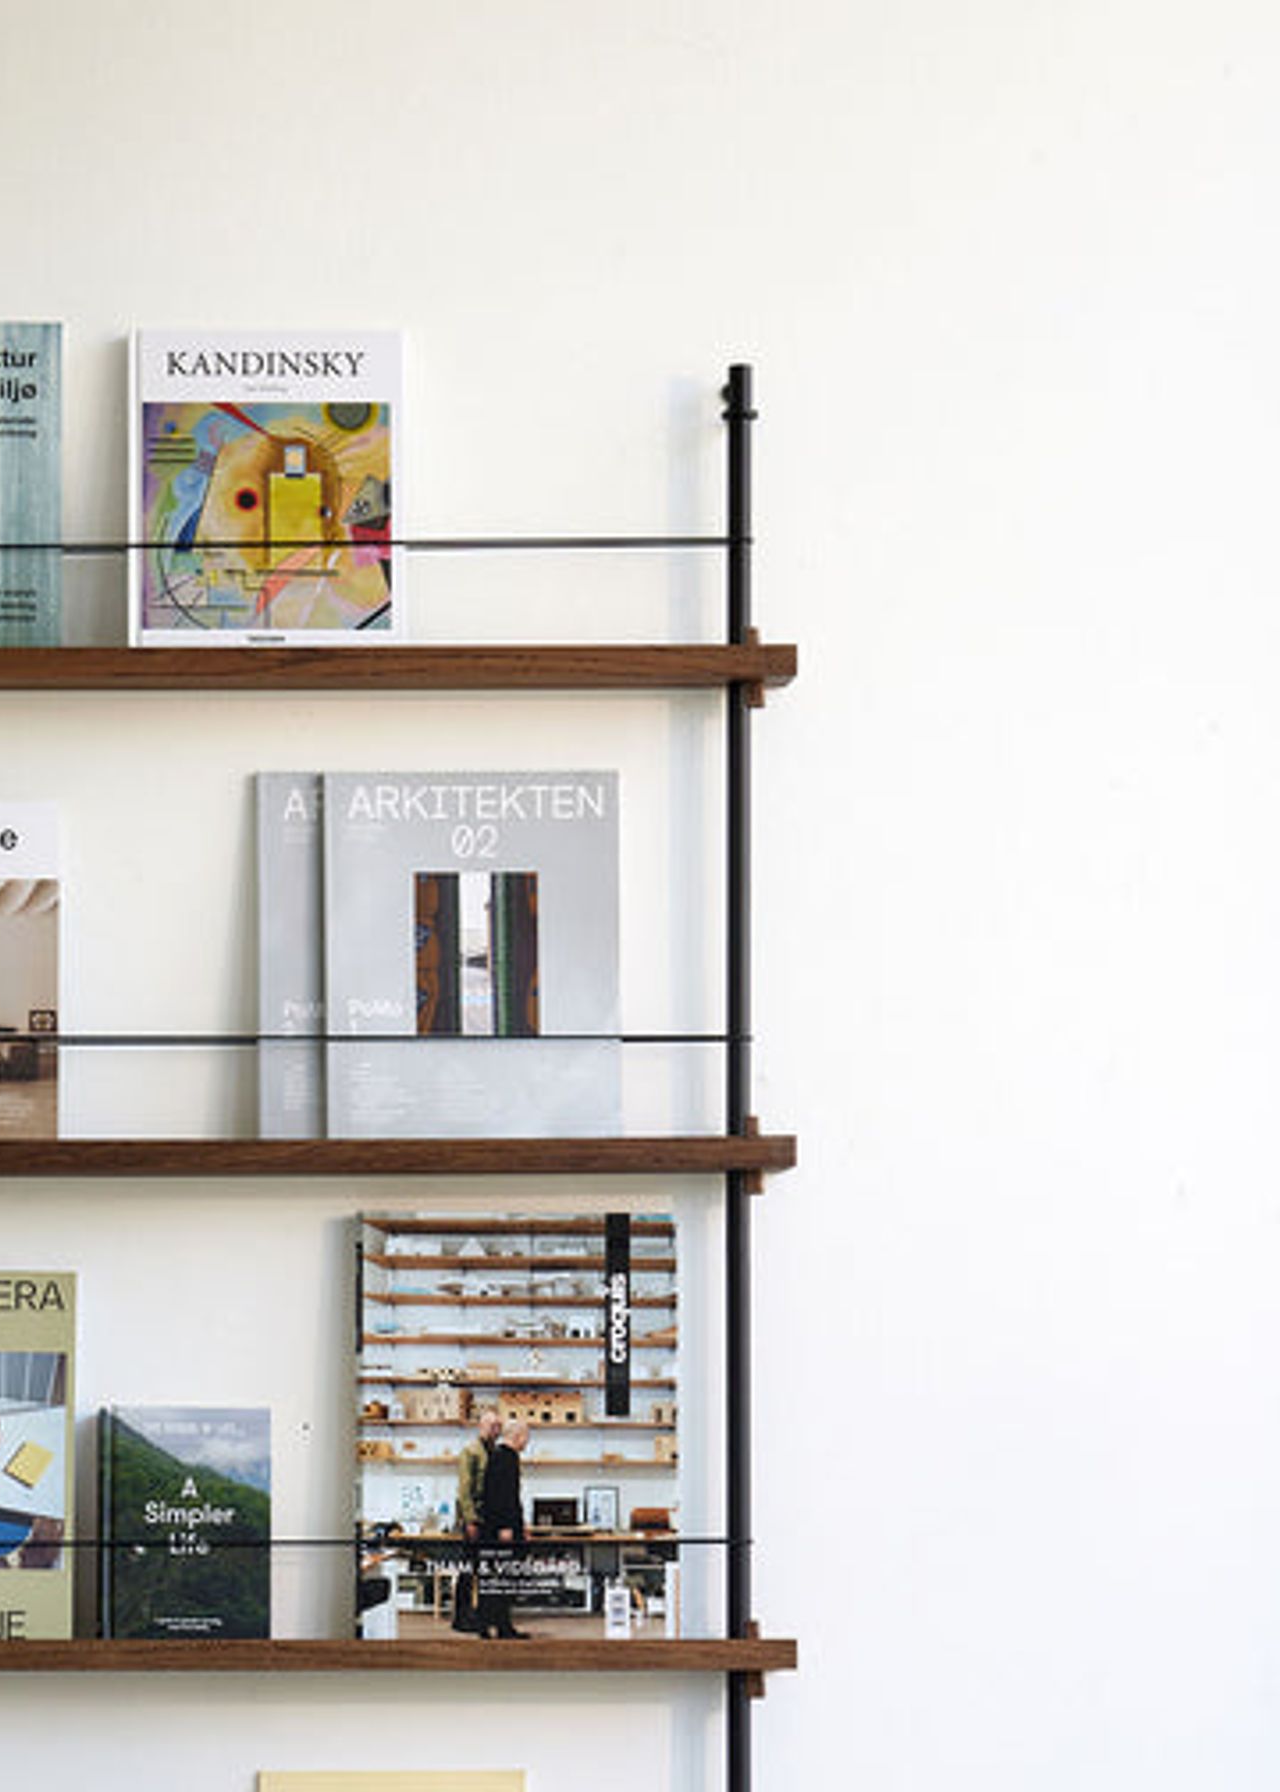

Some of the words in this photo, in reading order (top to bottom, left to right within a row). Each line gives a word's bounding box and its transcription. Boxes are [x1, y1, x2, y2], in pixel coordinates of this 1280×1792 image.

[166, 351, 365, 378] KANDINSKY
[347, 784, 605, 820] ARKITEKTEN
[451, 824, 500, 859] 02
[181, 1477, 199, 1498] A
[143, 1500, 236, 1529] Simpler
